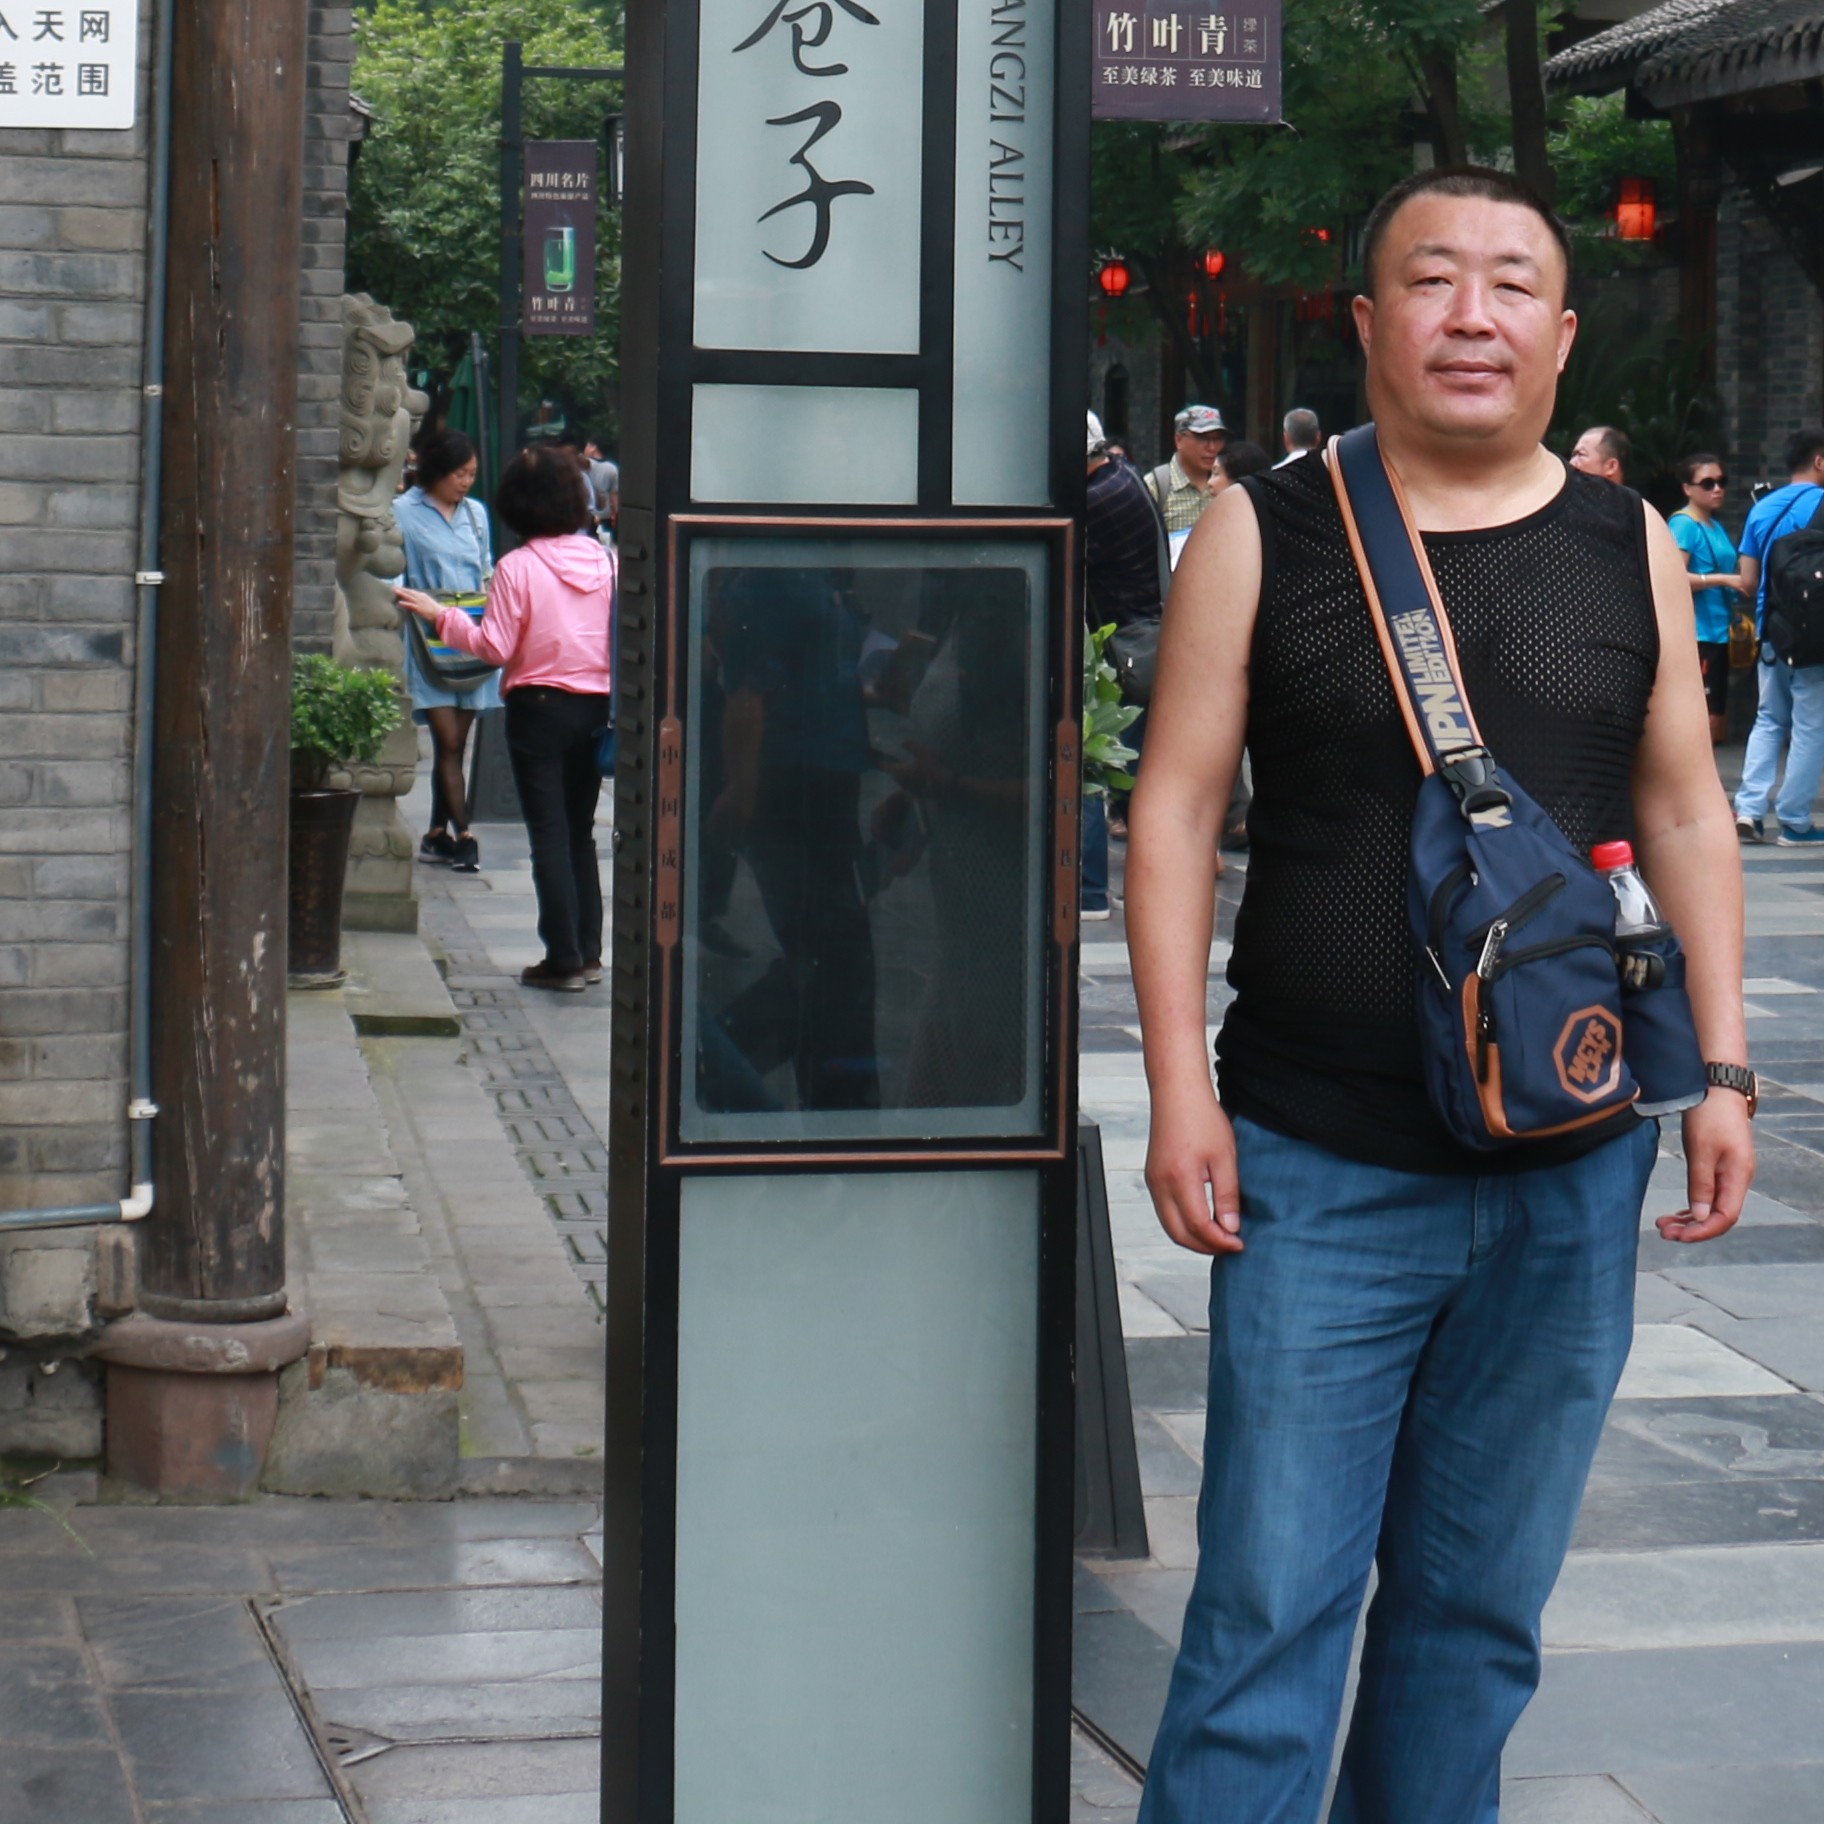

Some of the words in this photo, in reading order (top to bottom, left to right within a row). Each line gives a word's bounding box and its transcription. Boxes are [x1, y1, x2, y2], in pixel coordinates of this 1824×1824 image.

[1106, 12, 1228, 55] 竹叶青
[1102, 66, 1177, 86] 至美绿茶
[1188, 68, 1263, 89] 至美味道
[530, 172, 590, 188] 四川名片
[987, 137, 1026, 272] ALLEY
